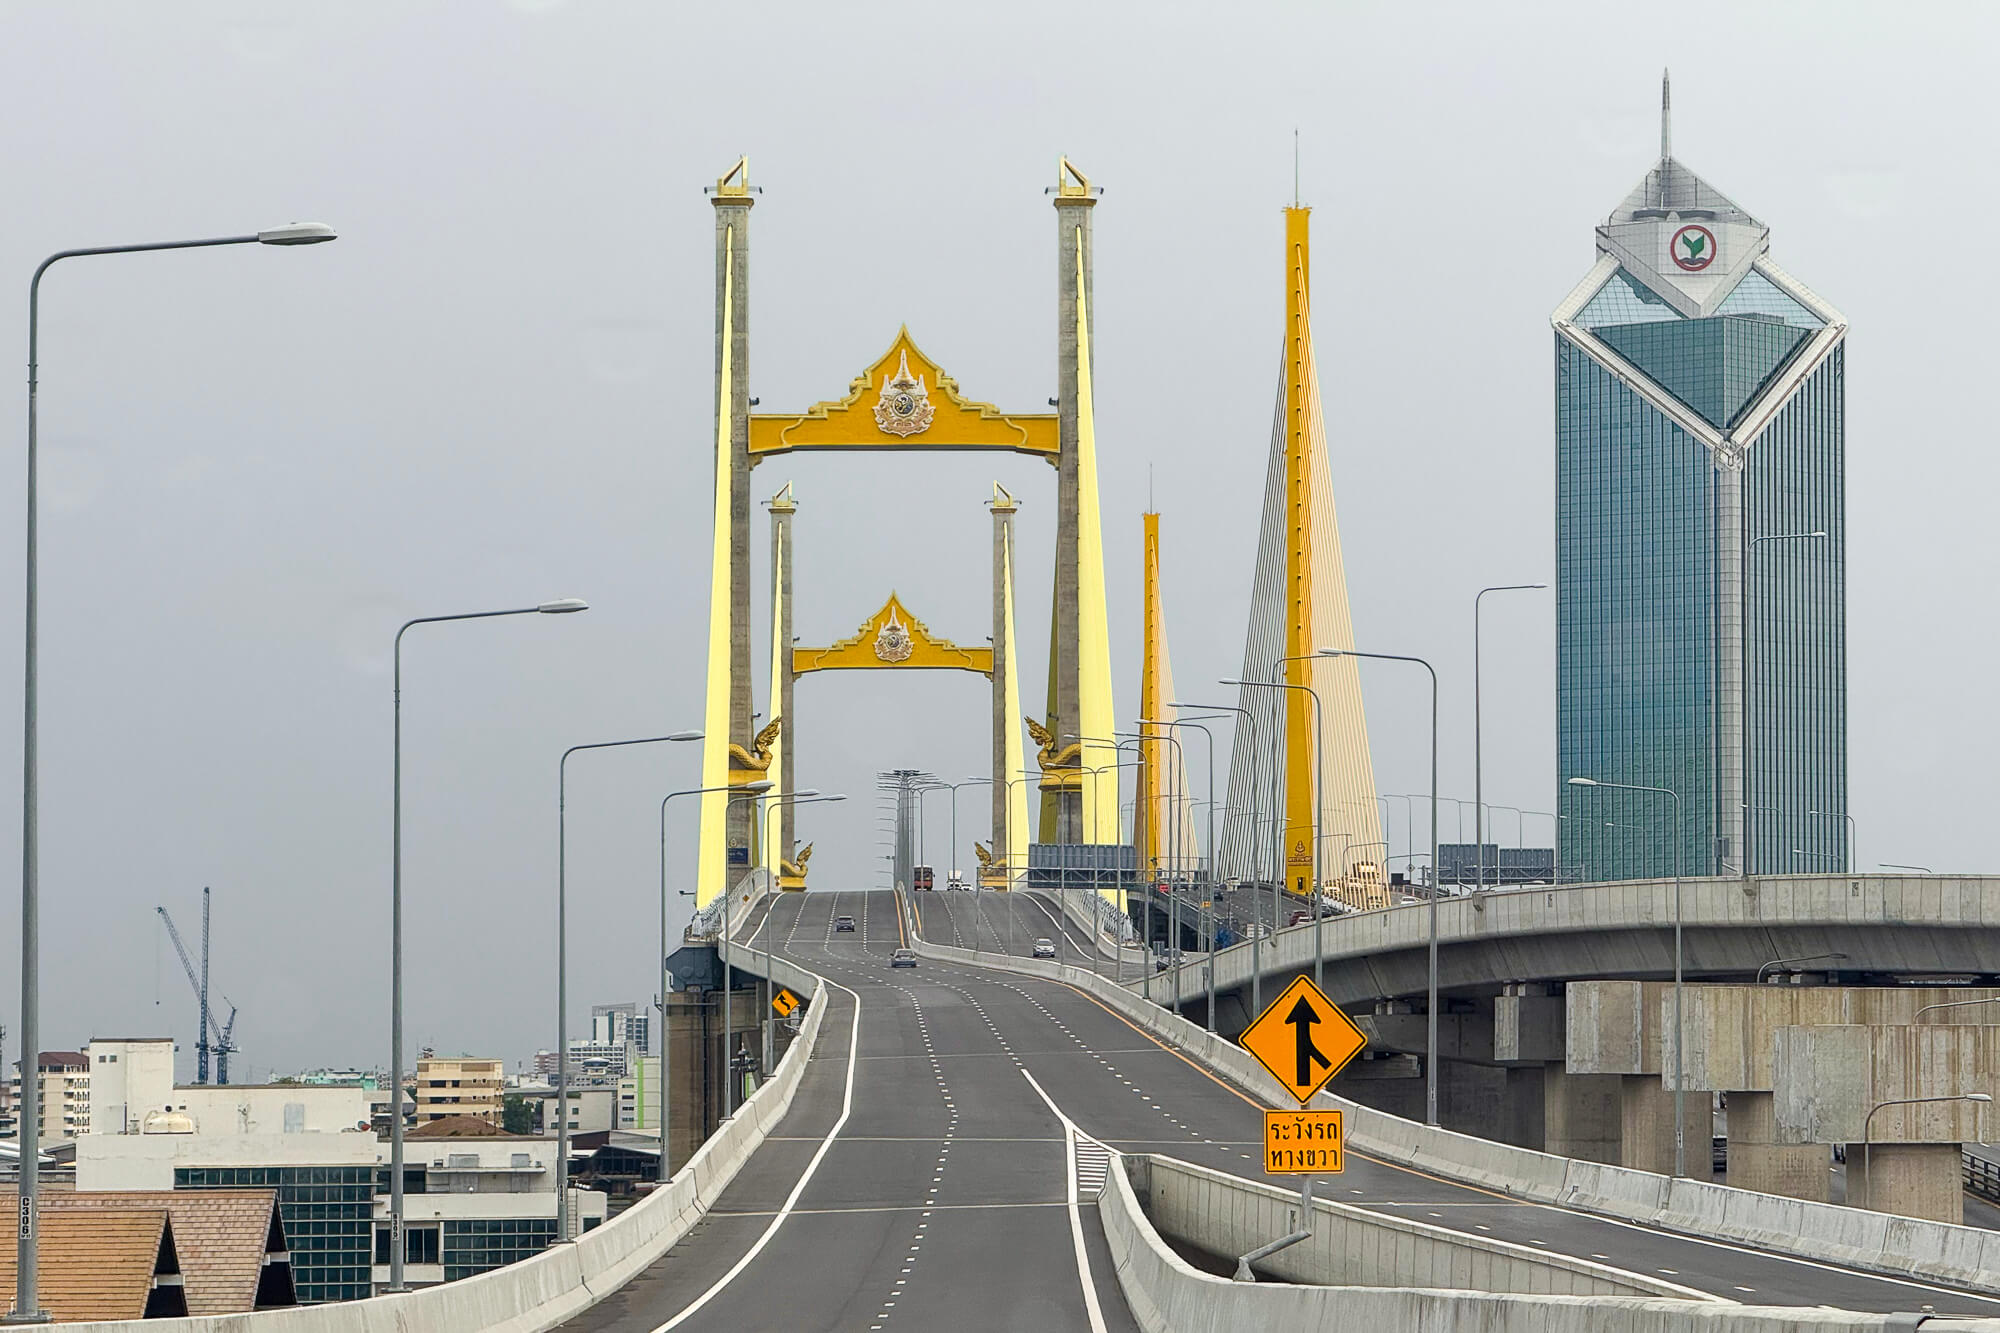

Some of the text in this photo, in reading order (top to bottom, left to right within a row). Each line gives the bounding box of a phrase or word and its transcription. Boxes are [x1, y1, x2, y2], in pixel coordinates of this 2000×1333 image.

[1271, 1116, 1337, 1140] ระวังรถ
[1271, 1150, 1337, 1167] ทางขวา
[22, 1197, 30, 1234] C306
